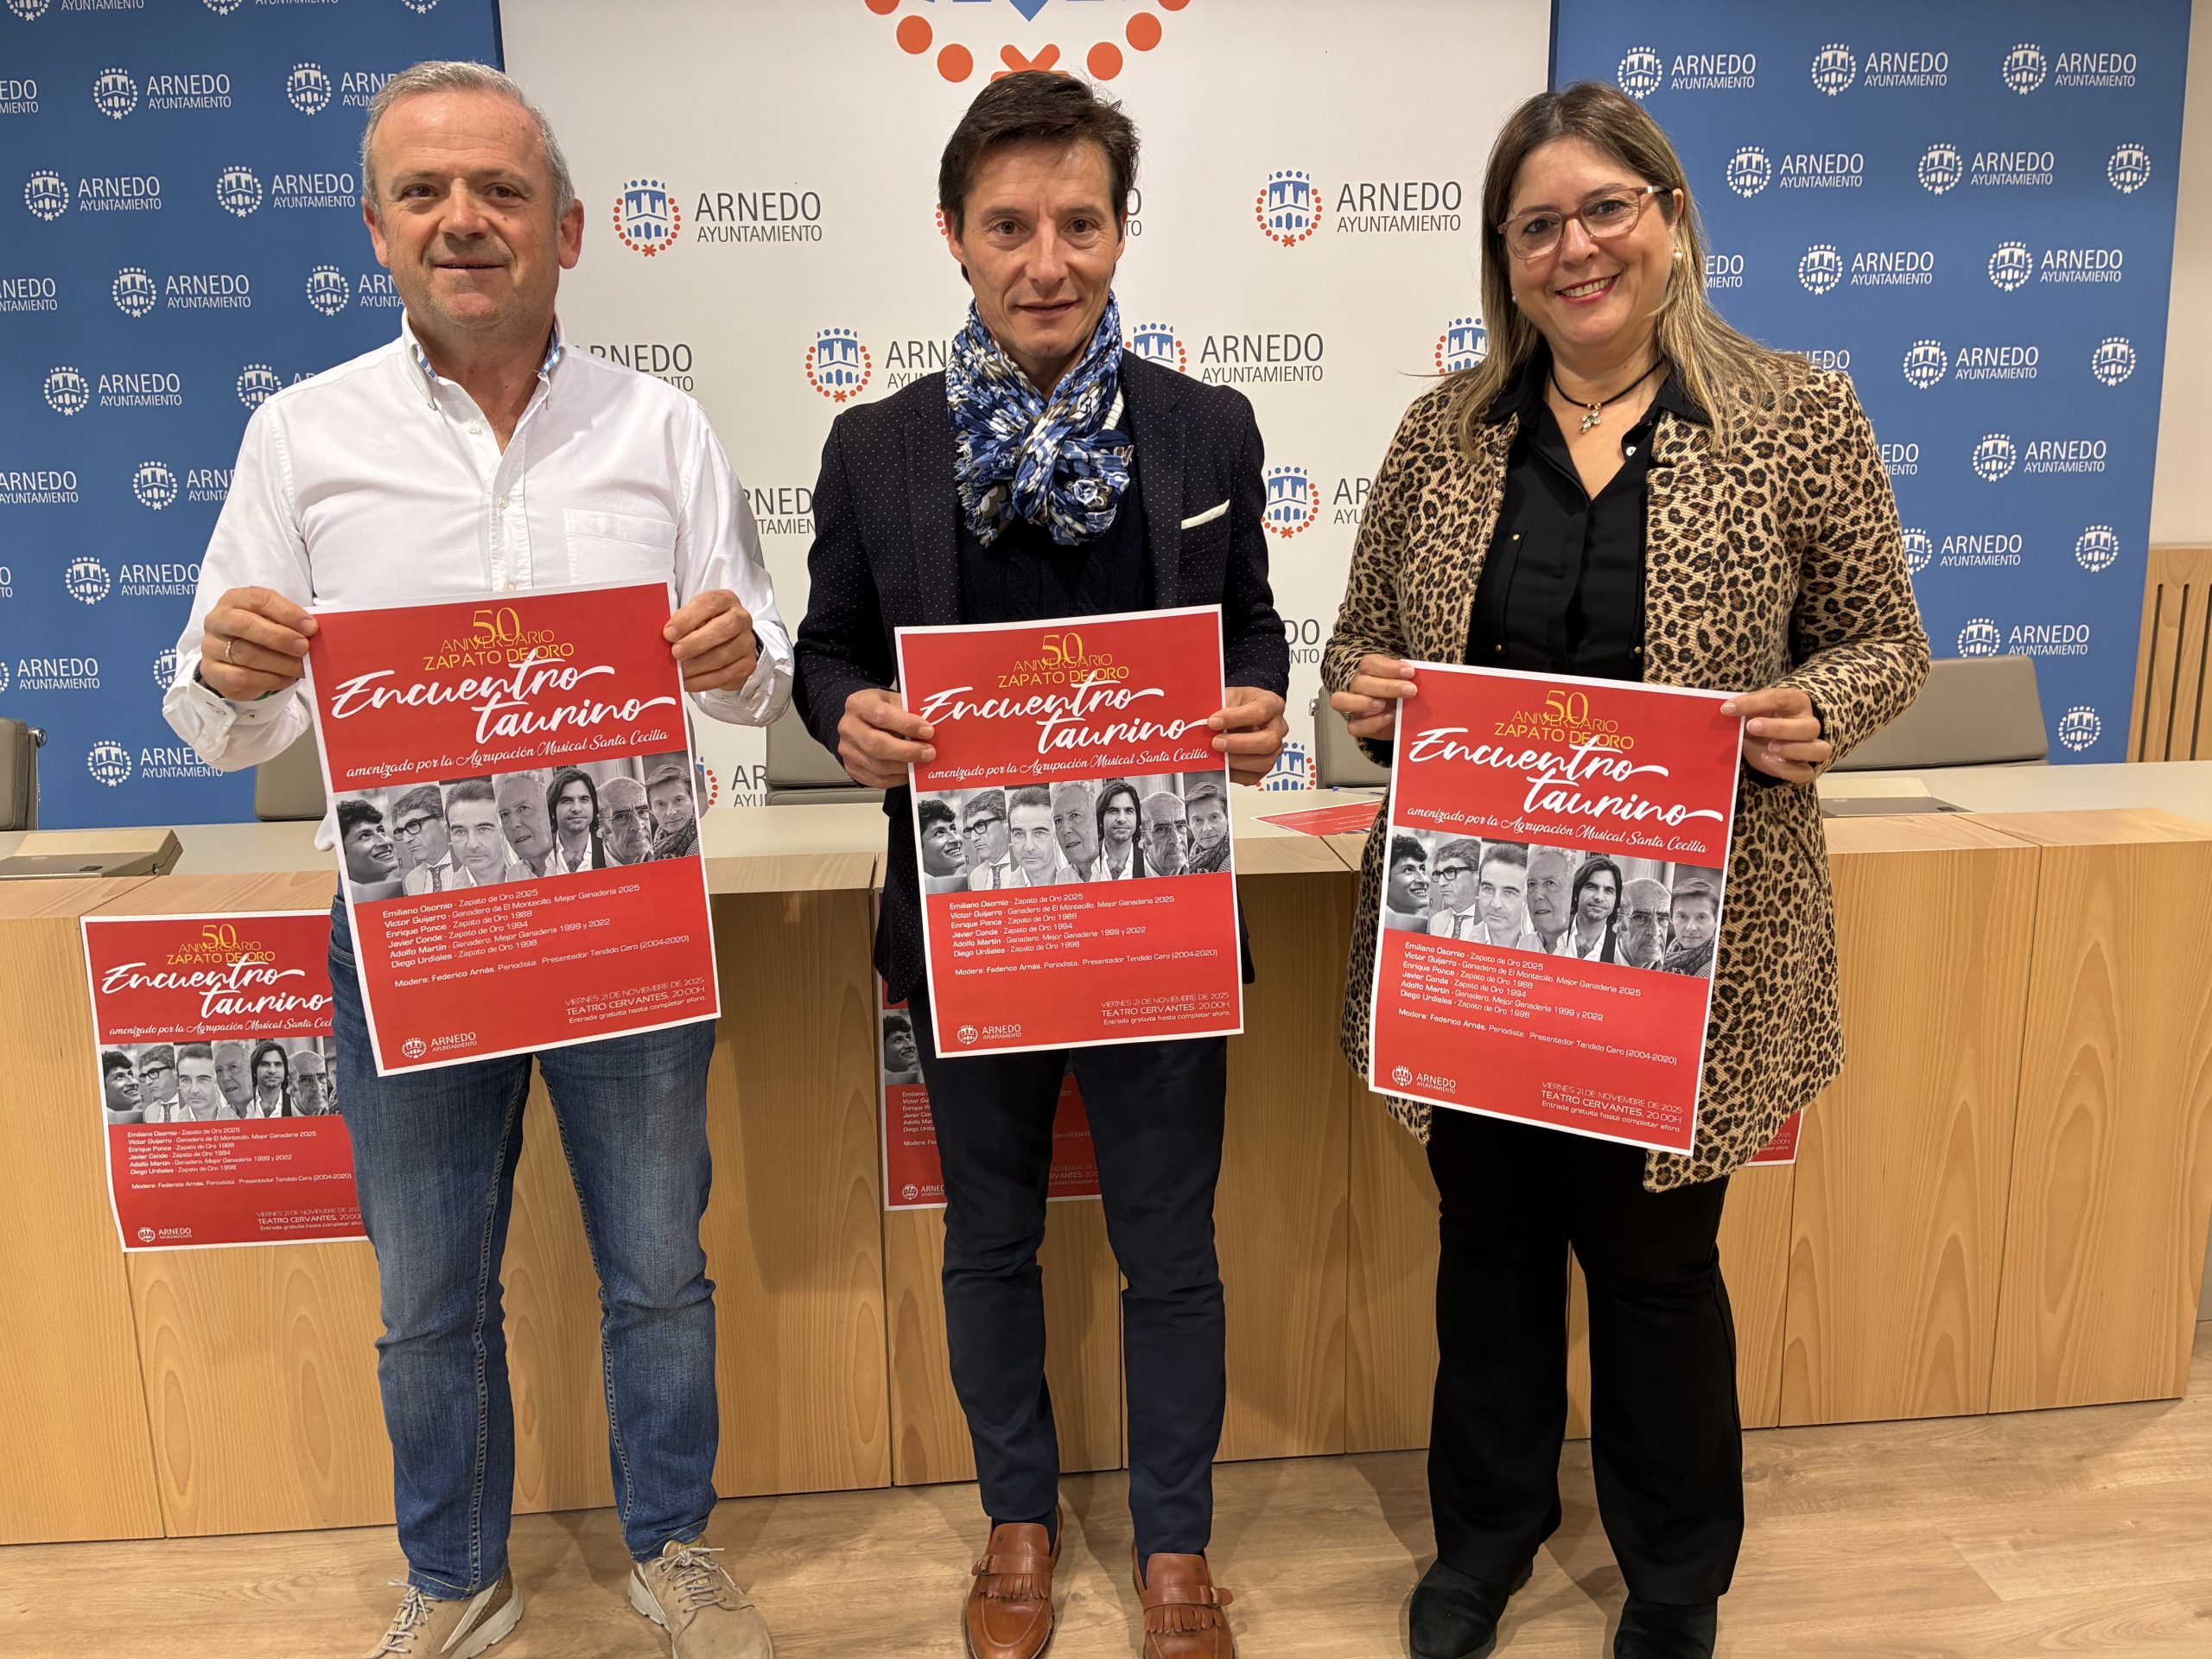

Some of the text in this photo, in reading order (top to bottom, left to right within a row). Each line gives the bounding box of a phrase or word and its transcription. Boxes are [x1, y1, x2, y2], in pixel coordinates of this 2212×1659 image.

[1671, 54, 1756, 75] ARNEDO
[1866, 53, 1948, 73] ARNEDO
[2056, 53, 2136, 73] ARNEDO
[147, 74, 230, 95] ARNEDO
[1671, 76, 1754, 89] AYUNTAMIENTO
[1865, 74, 1947, 86] AYUNTAMIENTO
[2055, 74, 2135, 86] AYUNTAMIENTO
[149, 96, 231, 109] AYUNTAMIENTO
[1780, 154, 1863, 175] ARNEDO
[1972, 152, 2054, 171] ARNEDO
[79, 176, 160, 197] ARNEDO
[272, 174, 353, 194] ARNEDO
[1780, 175, 1862, 188] AYUNTAMIENTO
[1971, 174, 2052, 185] AYUNTAMIENTO
[80, 198, 161, 211] AYUNTAMIENTO
[274, 196, 355, 207] AYUNTAMIENTO
[695, 192, 820, 221] ARNEDO
[1337, 181, 1461, 212] ARNEDO
[1338, 214, 1460, 232] AYUNTAMIENTO
[697, 226, 822, 242] AYUNTAMIENTO
[1852, 251, 1933, 272] ARNEDO
[2041, 250, 2122, 269] ARNEDO
[166, 275, 249, 294] ARNEDO
[1851, 273, 1932, 285] AYUNTAMIENTO
[2041, 270, 2121, 282] AYUNTAMIENTO
[168, 296, 251, 308] AYUNTAMIENTO
[1200, 334, 1323, 363] ARNEDO
[1956, 346, 2038, 366] ARNEDO
[99, 373, 180, 393] ARNEDO
[1201, 366, 1323, 384] AYUNTAMIENTO
[1955, 367, 2037, 379] AYUNTAMIENTO
[100, 395, 181, 406] AYUNTAMIENTO
[2024, 441, 2106, 460] ARNEDO
[2024, 461, 2105, 473] AYUNTAMIENTO
[1941, 535, 2022, 554] ARNEDO
[1941, 555, 2020, 566] AYUNTAMIENTO
[119, 564, 201, 583] ARNEDO
[470, 607, 523, 645] 50
[2009, 625, 2089, 643] ARNEDO
[440, 629, 554, 652] ANIVERSARIO
[1040, 632, 1084, 665] 50
[423, 642, 574, 671] ZAPATO DE ORO
[2009, 645, 2088, 657] AYUNTAMIENTO
[18, 658, 98, 677] ARNEDO
[1013, 653, 1112, 672] ANIVERSARIO
[20, 678, 99, 690] AYUNTAMIENTO
[332, 648, 614, 719] Encuentro
[997, 665, 1129, 688] ZAPATO DE ORO
[920, 671, 1164, 725] Encuentro
[1543, 689, 1591, 726] 50
[471, 691, 676, 744] taurino
[1511, 710, 1618, 733] ANIVERSARIO
[1036, 708, 1209, 754] taurino
[1494, 722, 1634, 749] ZAPATO DE ORO
[346, 728, 668, 779] amenizado por la Agrupación Musical Santa Cecilia
[1409, 728, 1669, 782] Encuentro
[927, 747, 1207, 781] amenizado por la Agrupación Musical Santa Cecilia
[1523, 767, 1724, 826] taurino
[1407, 808, 1707, 853] amenizado por la Agrupación Musical Santa Cecilia
[178, 941, 261, 952] ANIVERSARIO
[200, 924, 238, 949] 50
[166, 951, 275, 964] ZAPATO DE ORO
[391, 959, 416, 968] Diego
[417, 954, 452, 963] Urdiales
[458, 949, 486, 957] Zapato
[516, 939, 537, 948] 1998
[1405, 941, 1434, 952] Emiliano
[1470, 952, 1495, 963] Zapato
[1507, 958, 1520, 967] Oro
[1522, 961, 1543, 970] 2025
[102, 953, 305, 994] Encuentro
[1461, 961, 1497, 972] Ganadero
[1556, 976, 1578, 986] Mejor
[1618, 986, 1641, 996] 2025
[199, 982, 333, 1019] taurino
[566, 1002, 606, 1014] TEATRO
[1401, 980, 1423, 989] Adolfo
[1425, 983, 1449, 994] Martín
[1491, 995, 1513, 1005] Mejor
[1554, 1006, 1574, 1015] 1999
[1581, 1011, 1603, 1020] 2022
[1101, 1007, 1138, 1016] TEATRO
[430, 1032, 476, 1046] ARNEDO
[982, 1024, 1020, 1034] ARNEDO
[1430, 1014, 1461, 1026] Federico
[1529, 1032, 1574, 1046] Presentador
[1576, 1039, 1605, 1051] Tendido
[1605, 1046, 1624, 1054] Cero
[1416, 1072, 1456, 1088] ARNEDO
[1541, 1090, 1580, 1104] TEATRO
